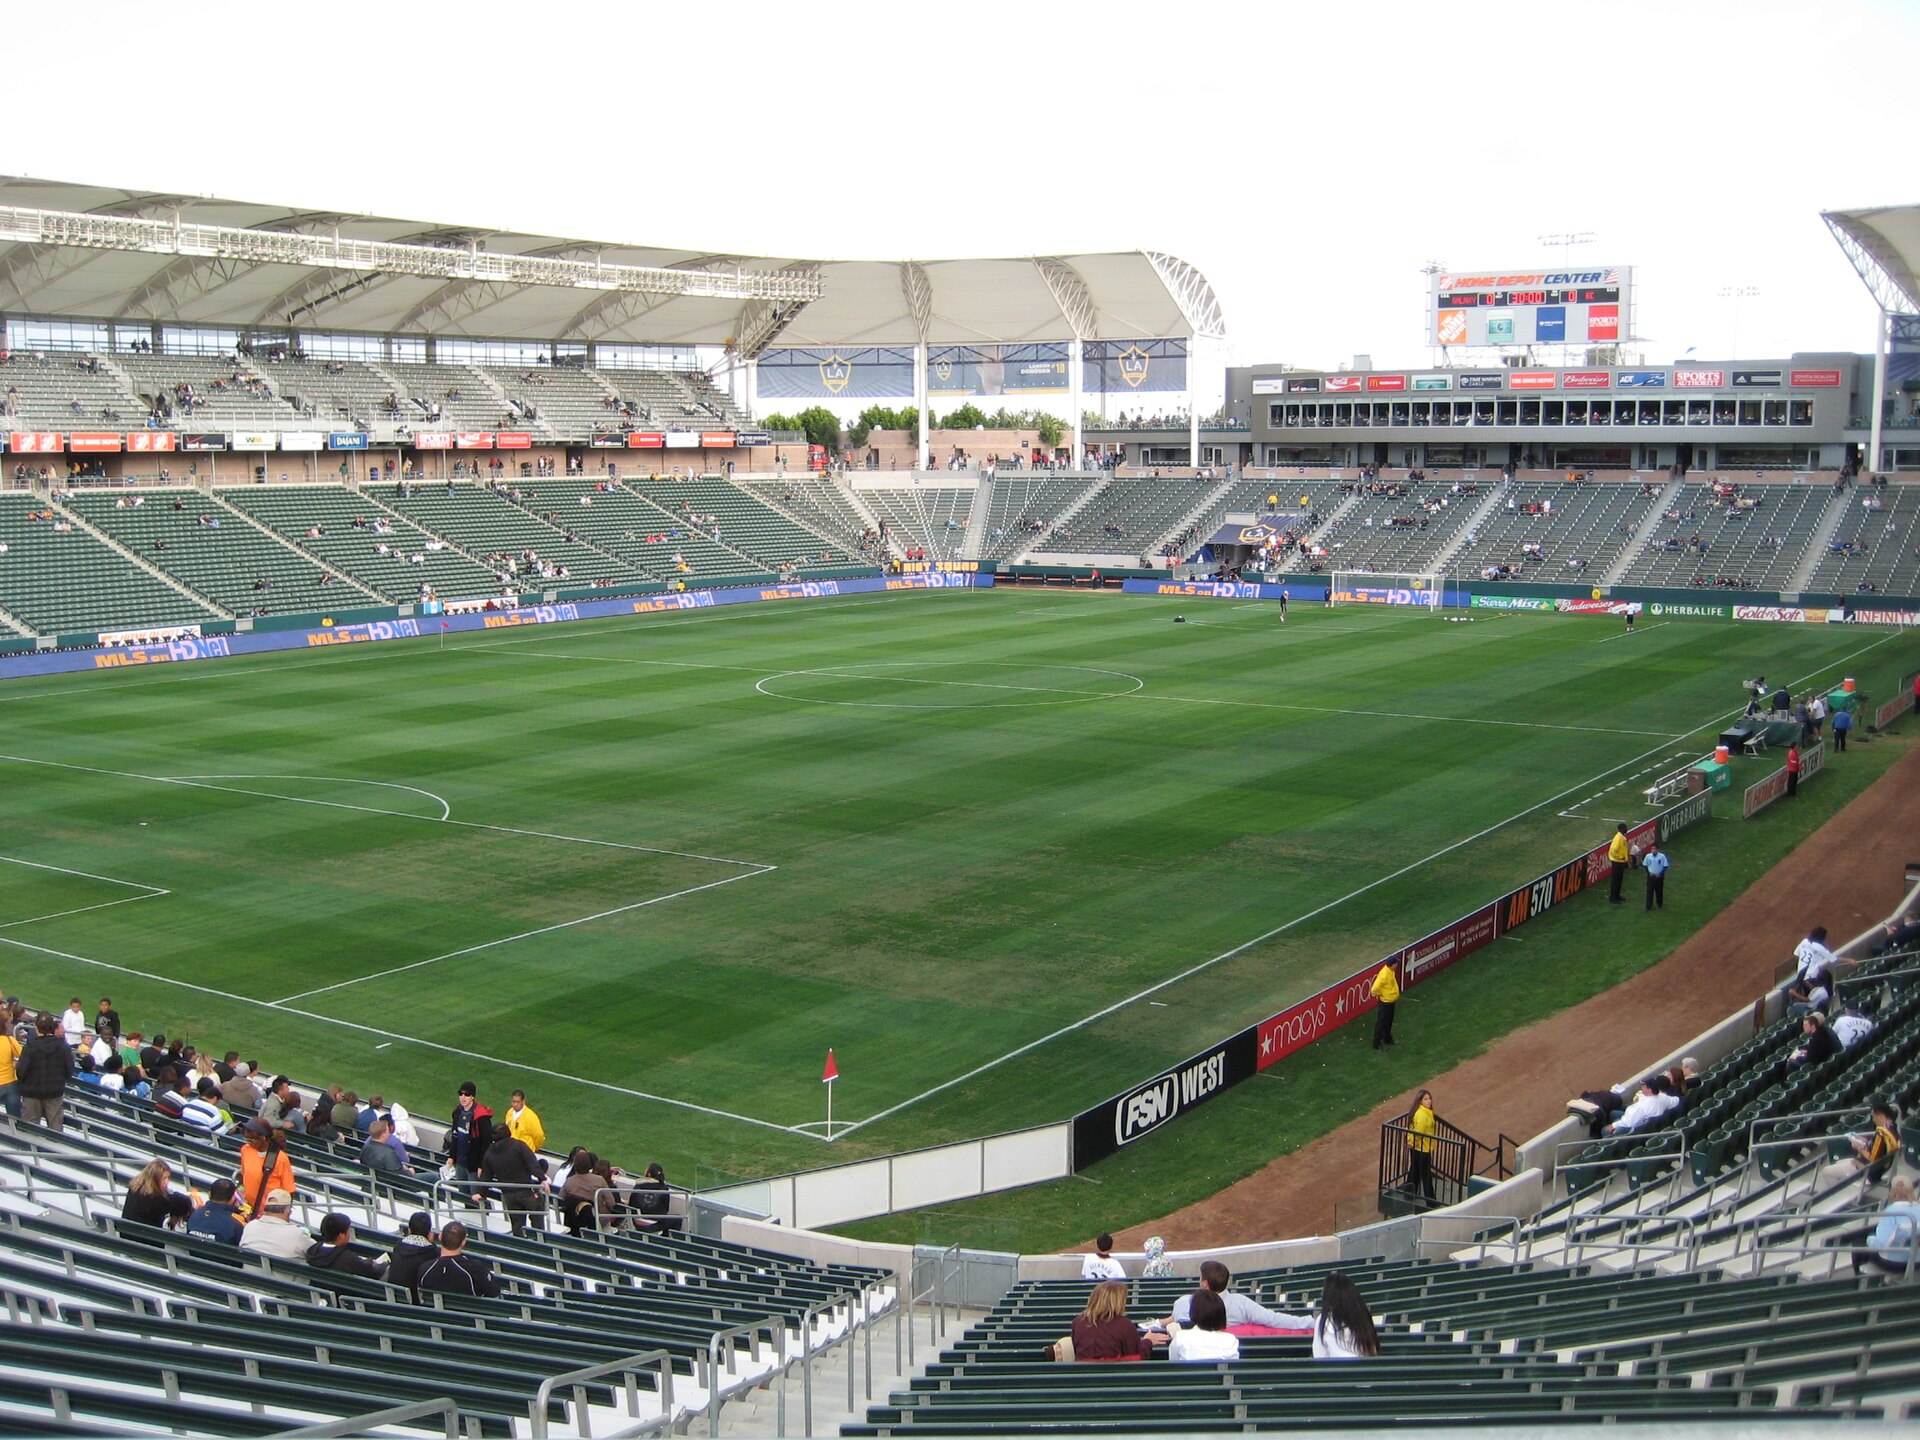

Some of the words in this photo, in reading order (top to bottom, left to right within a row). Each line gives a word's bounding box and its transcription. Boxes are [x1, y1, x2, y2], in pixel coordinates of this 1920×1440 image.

[1455, 276, 1496, 288] HOME
[1496, 274, 1544, 287] DEPOT
[1544, 272, 1602, 284] CENTER
[1486, 293, 1494, 305] 0
[1512, 291, 1542, 304] 30:00
[1568, 290, 1575, 302] 0
[1126, 360, 1143, 371] LA
[827, 368, 845, 378] LA
[1563, 373, 1608, 384] Budweiser
[1619, 375, 1634, 383] ADT
[1676, 371, 1720, 381] SPORTS
[336, 436, 360, 446] DASANI
[903, 562, 931, 572] RIOT
[935, 561, 979, 572] SQUAD
[885, 580, 913, 590] MLS
[1158, 584, 1196, 595] MLS
[1196, 588, 1213, 596] on
[760, 589, 790, 600] MLS
[633, 600, 666, 613] MLS
[1479, 596, 1508, 608] Sierra
[1508, 598, 1540, 609] Mist
[1560, 599, 1615, 613] Budweiser
[1665, 605, 1723, 616] HERBALIFE
[483, 613, 522, 628] MLS
[523, 616, 537, 624] on
[307, 630, 351, 646] MLS
[353, 633, 371, 642] on
[95, 650, 149, 668] MLS
[150, 653, 171, 663] on
[1668, 798, 1706, 833] HERBALIFE
[1506, 888, 1531, 929] AM
[1530, 876, 1553, 918] 570
[1554, 860, 1584, 904] KLAC
[1801, 951, 1812, 964] 23
[1126, 1080, 1170, 1137] FSN
[1181, 1051, 1226, 1105] WEST
